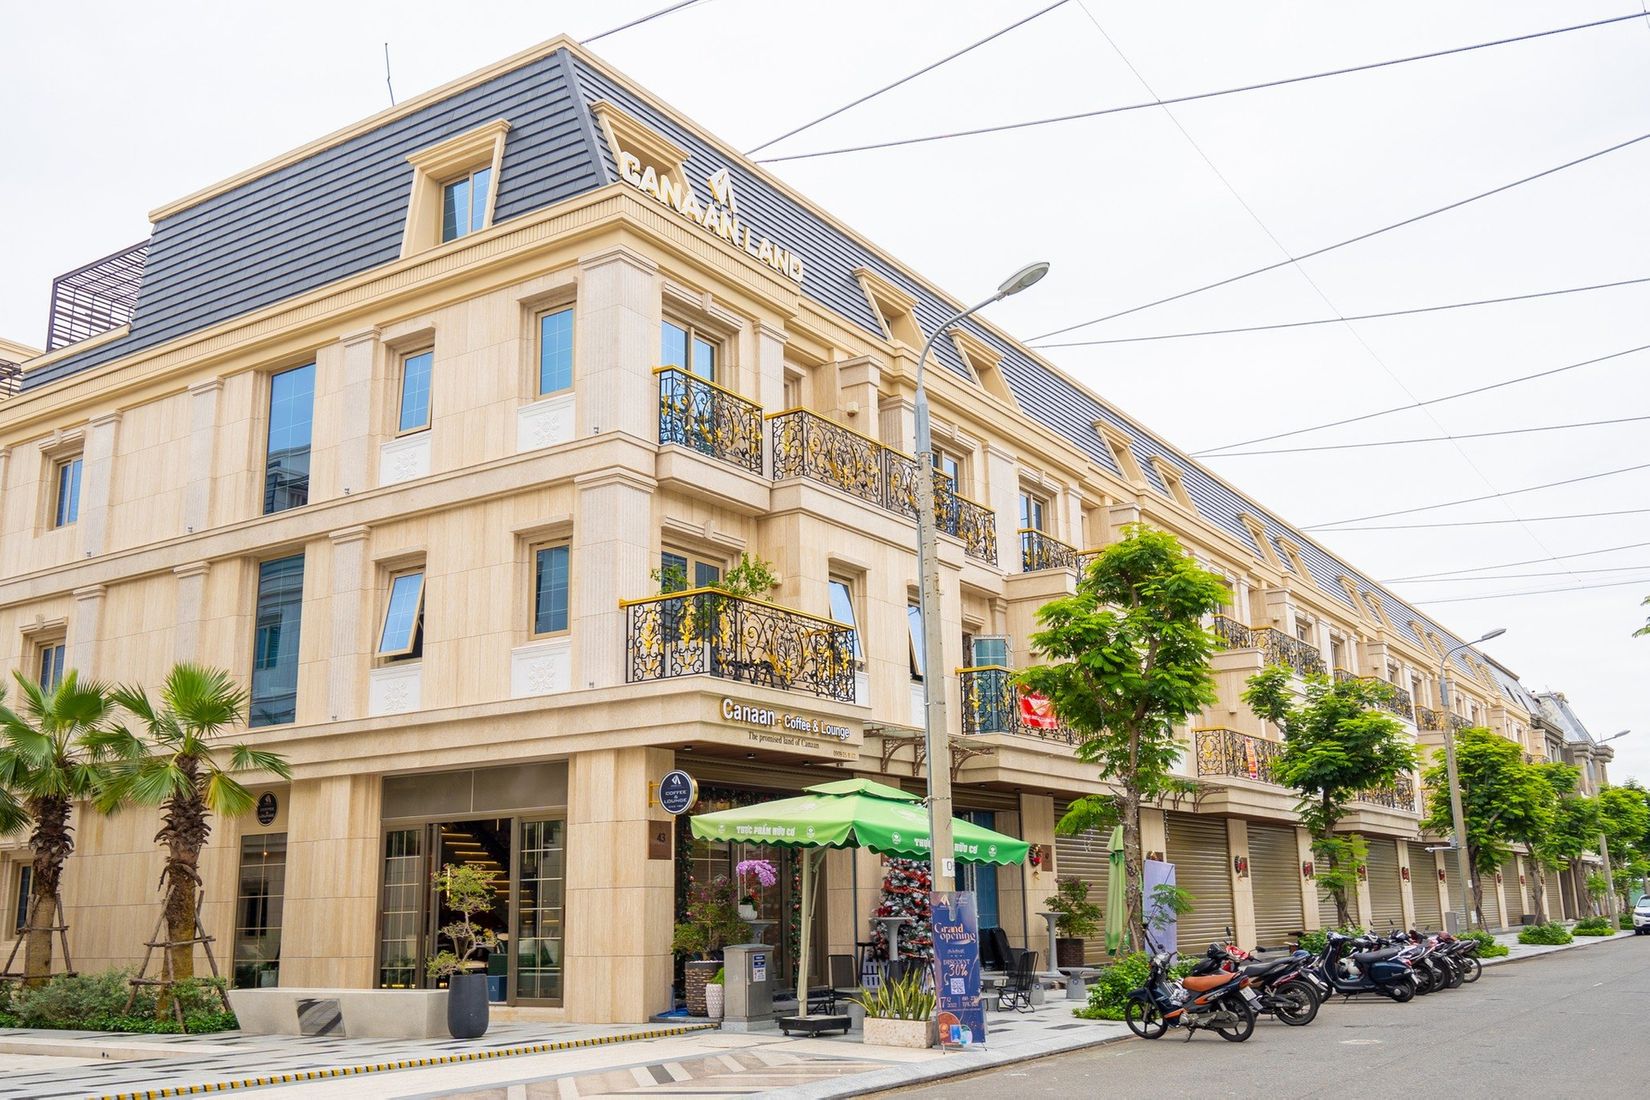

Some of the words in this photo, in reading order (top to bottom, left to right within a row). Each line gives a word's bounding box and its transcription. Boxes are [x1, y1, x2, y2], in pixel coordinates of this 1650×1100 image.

[620, 151, 743, 247] CANAAN
[744, 226, 804, 283] LAND
[723, 698, 776, 726] Canaan
[784, 714, 811, 731] Coffee
[812, 720, 819, 733] &
[821, 721, 850, 740] Lounge
[748, 731, 758, 741] The
[759, 733, 782, 744] promised
[783, 735, 795, 746] land
[795, 737, 801, 747] of
[801, 738, 820, 749] Canaan
[656, 832, 666, 843] 43
[934, 922, 964, 933] Grand
[940, 932, 977, 944] opening
[949, 964, 968, 977] 30%
